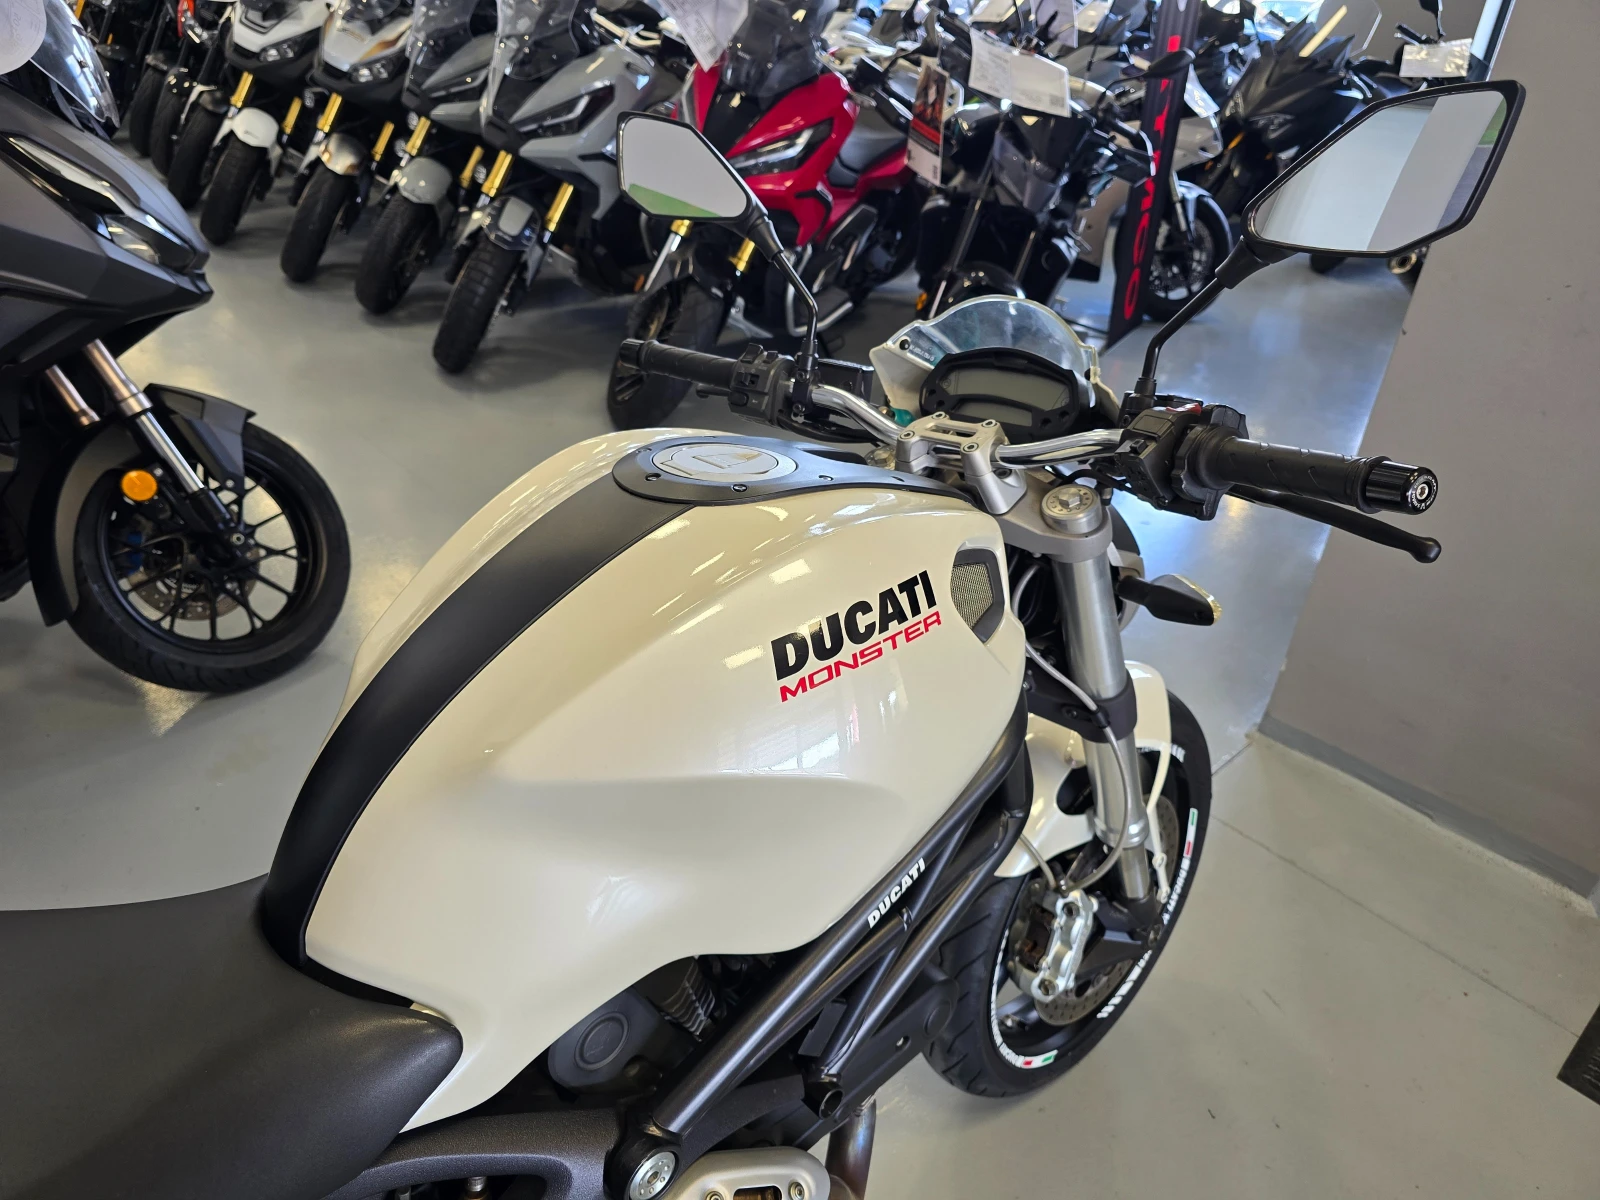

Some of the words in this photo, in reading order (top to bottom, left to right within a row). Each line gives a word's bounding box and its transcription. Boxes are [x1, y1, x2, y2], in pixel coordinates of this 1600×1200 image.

[771, 570, 937, 681] DUCATI
[780, 611, 942, 702] MONSTER
[868, 857, 925, 929] DUCATI
